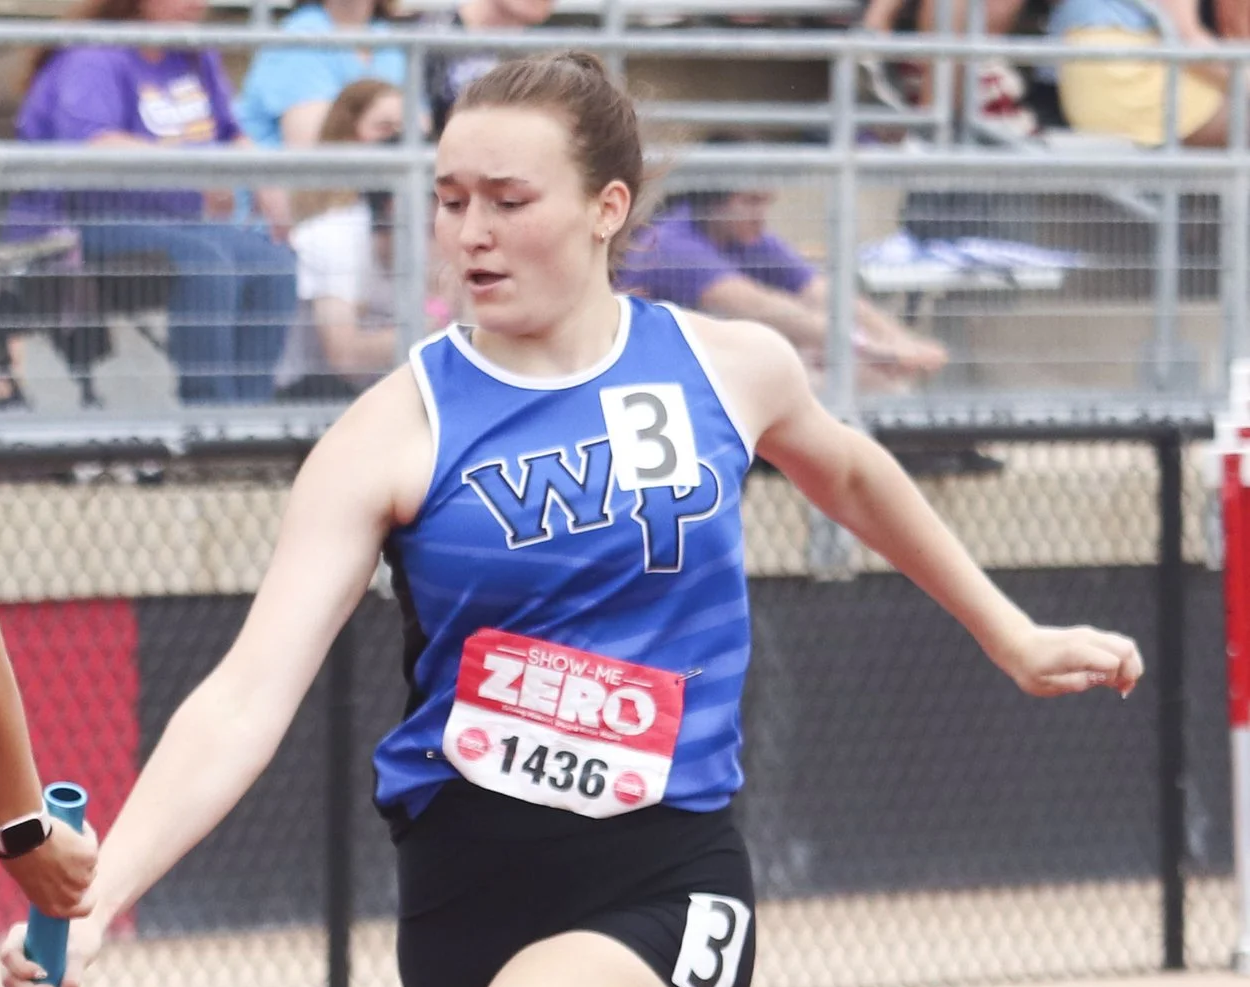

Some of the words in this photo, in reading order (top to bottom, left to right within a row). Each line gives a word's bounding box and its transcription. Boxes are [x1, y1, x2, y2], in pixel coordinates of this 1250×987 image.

[621, 391, 678, 479] 3
[478, 654, 656, 736] ZERO
[527, 648, 625, 686] SHOW-ME
[500, 735, 609, 799] 1436
